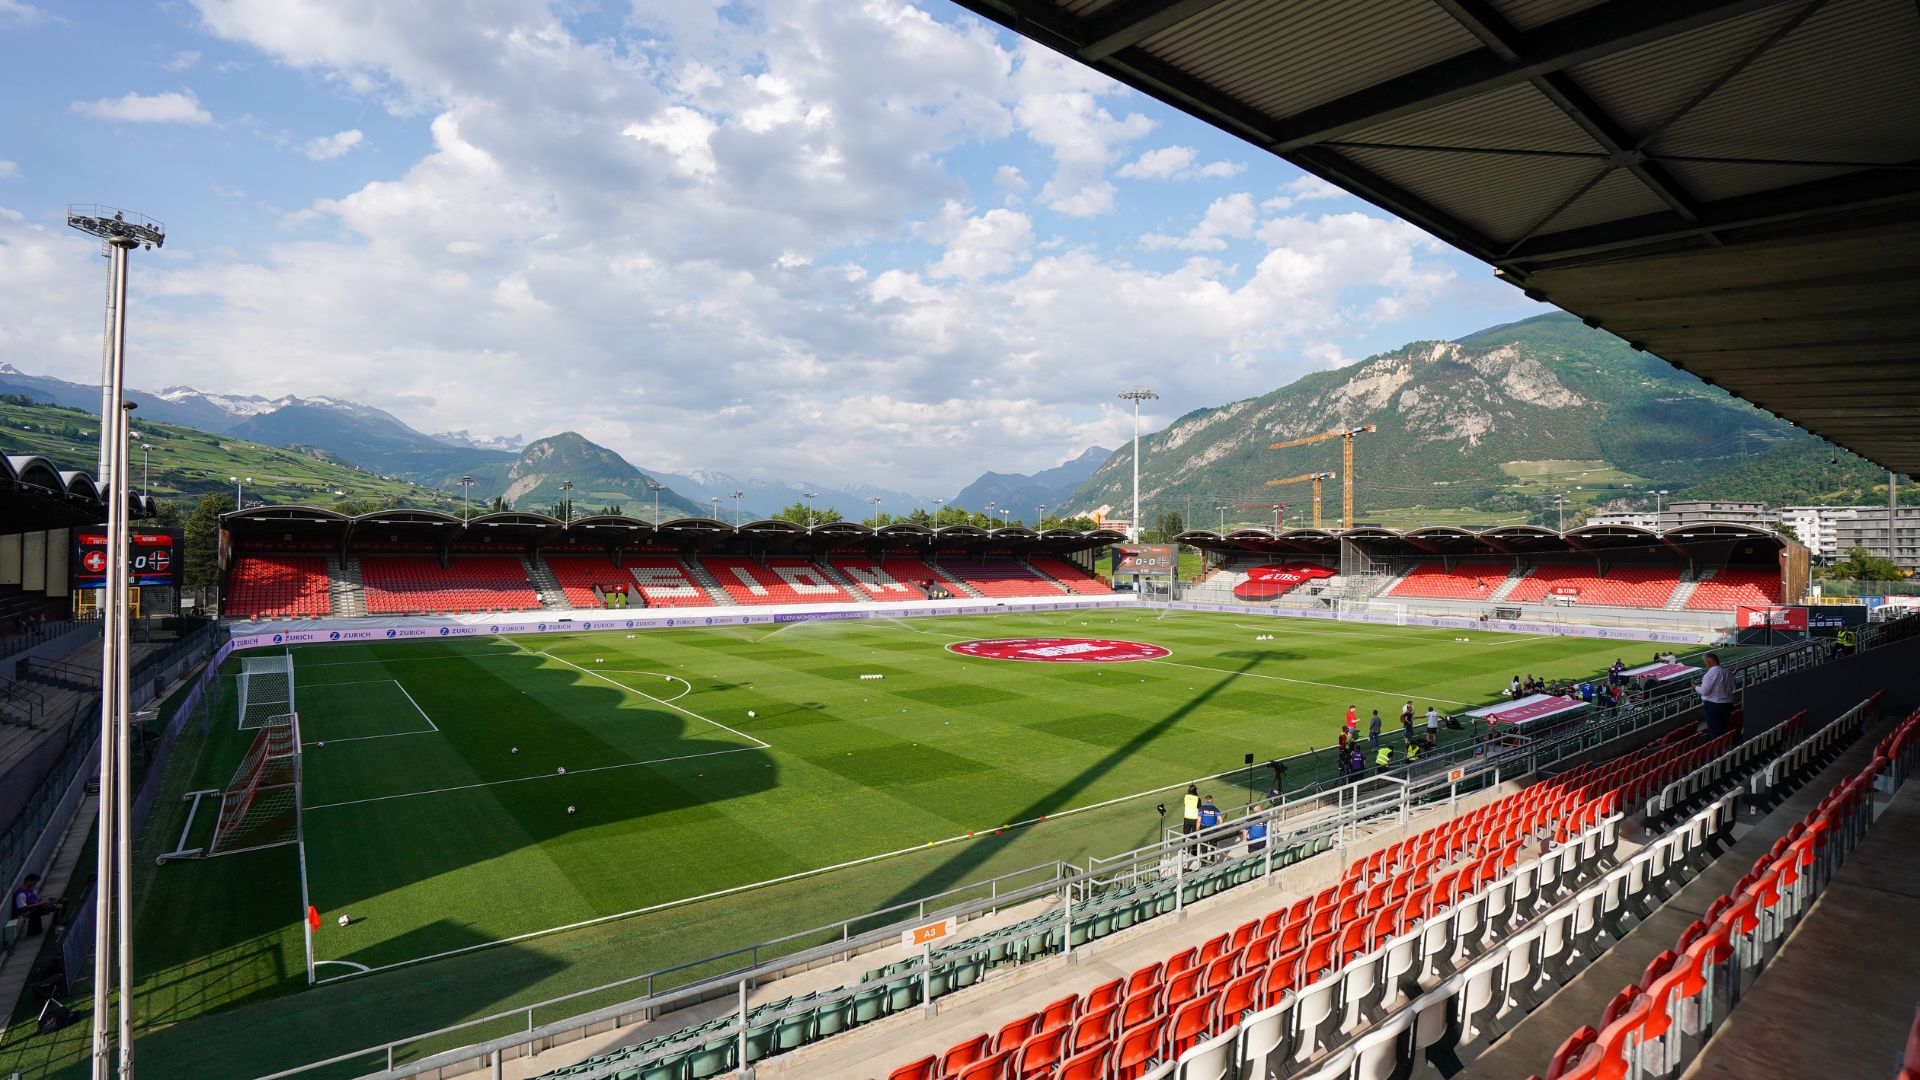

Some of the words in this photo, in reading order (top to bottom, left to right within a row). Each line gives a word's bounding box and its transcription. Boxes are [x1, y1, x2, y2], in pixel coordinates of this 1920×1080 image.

[1273, 573, 1301, 582] UBS
[236, 638, 259, 647] ZURICH
[923, 928, 936, 939] A3
